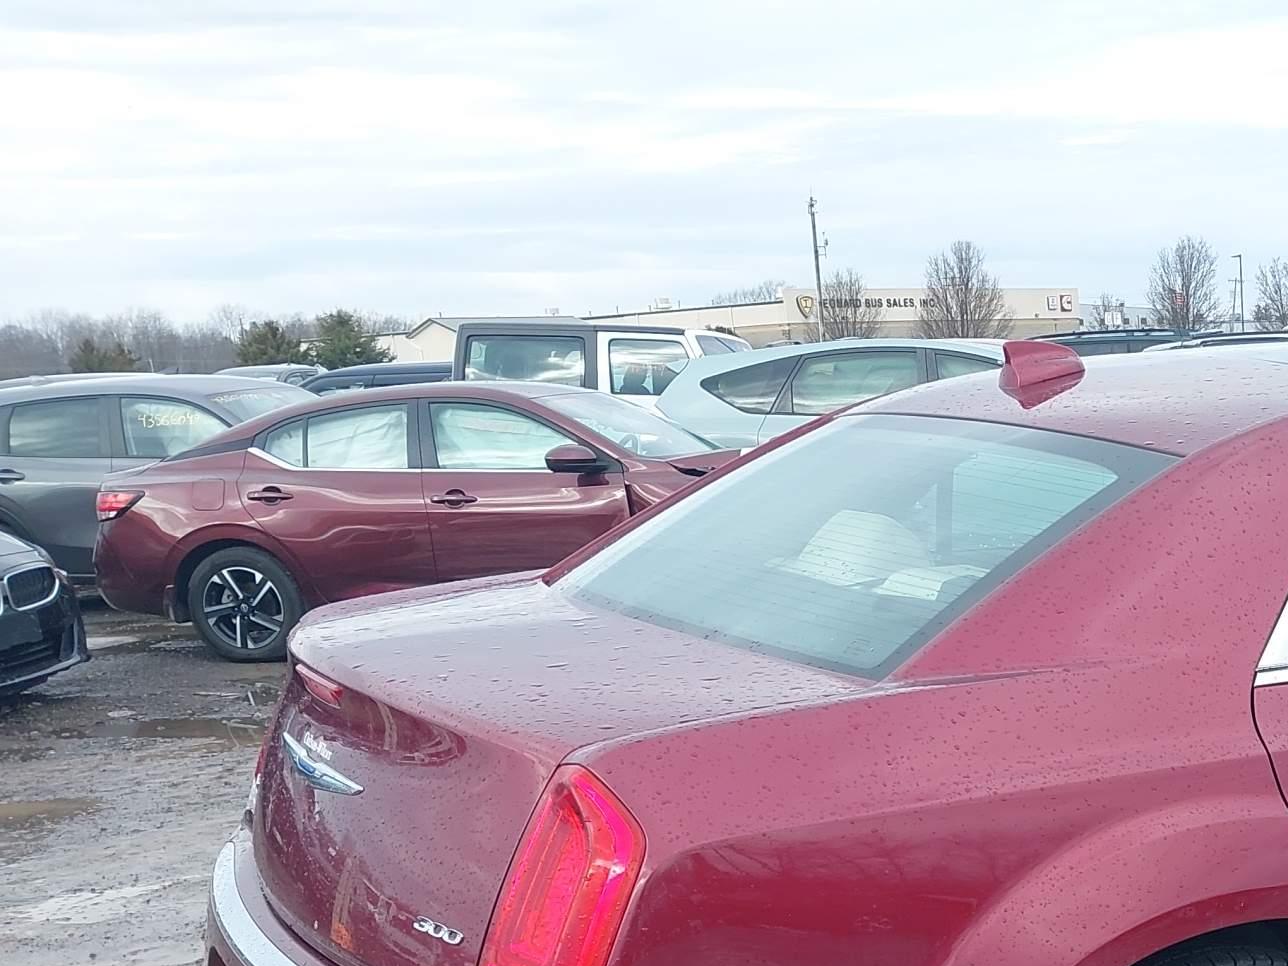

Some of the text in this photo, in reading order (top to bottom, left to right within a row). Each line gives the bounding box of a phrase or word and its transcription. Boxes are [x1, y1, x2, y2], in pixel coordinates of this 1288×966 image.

[818, 298, 861, 309] EONARD
[865, 298, 883, 309] BUS
[886, 297, 917, 310] SALES,
[413, 915, 464, 945] 300
